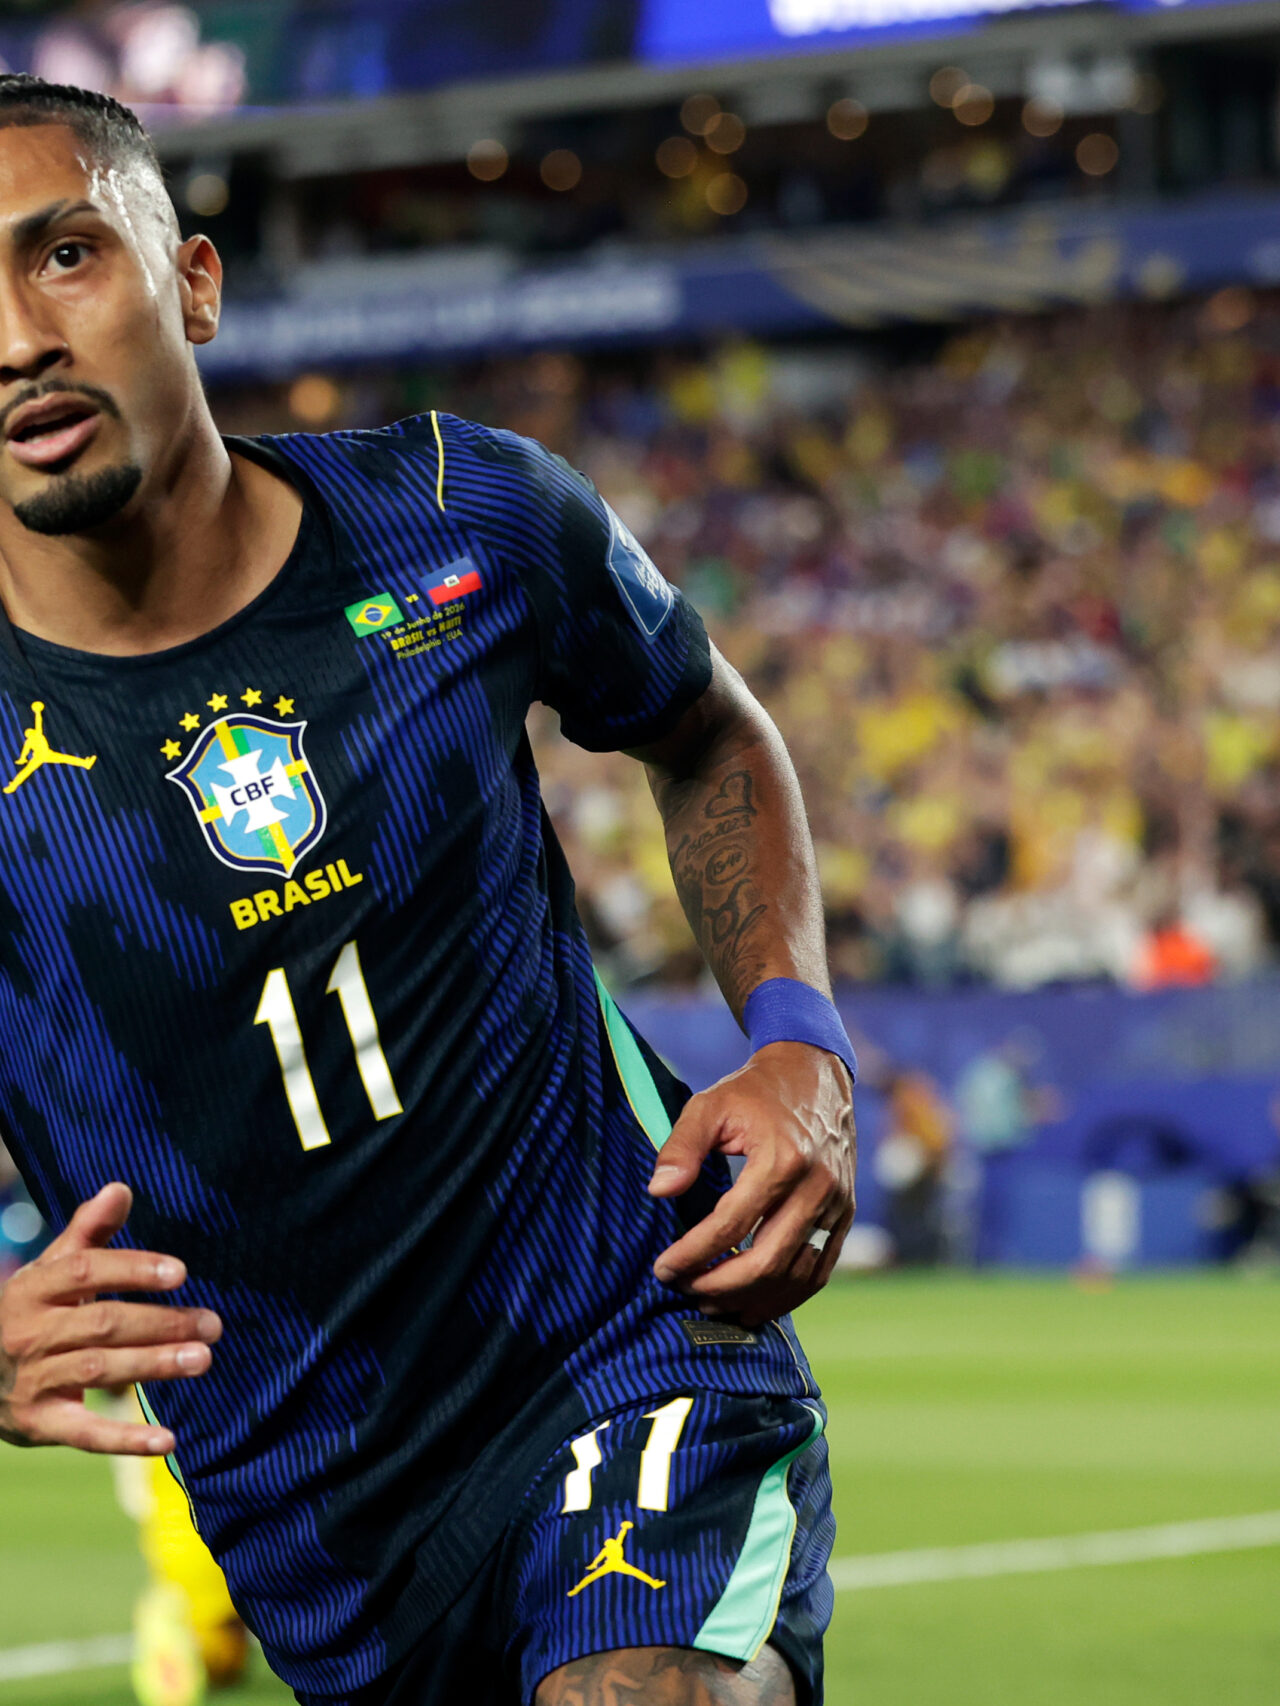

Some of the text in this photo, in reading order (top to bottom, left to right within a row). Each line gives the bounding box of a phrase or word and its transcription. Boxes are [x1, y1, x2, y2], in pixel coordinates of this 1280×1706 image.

[405, 593, 419, 603] vs
[394, 626, 406, 635] de
[432, 610, 443, 620] de
[446, 628, 463, 641] EUA
[230, 776, 275, 806] CBF
[229, 858, 363, 931] BRASIL
[253, 939, 404, 1152] 11
[562, 1397, 694, 1514] 11
